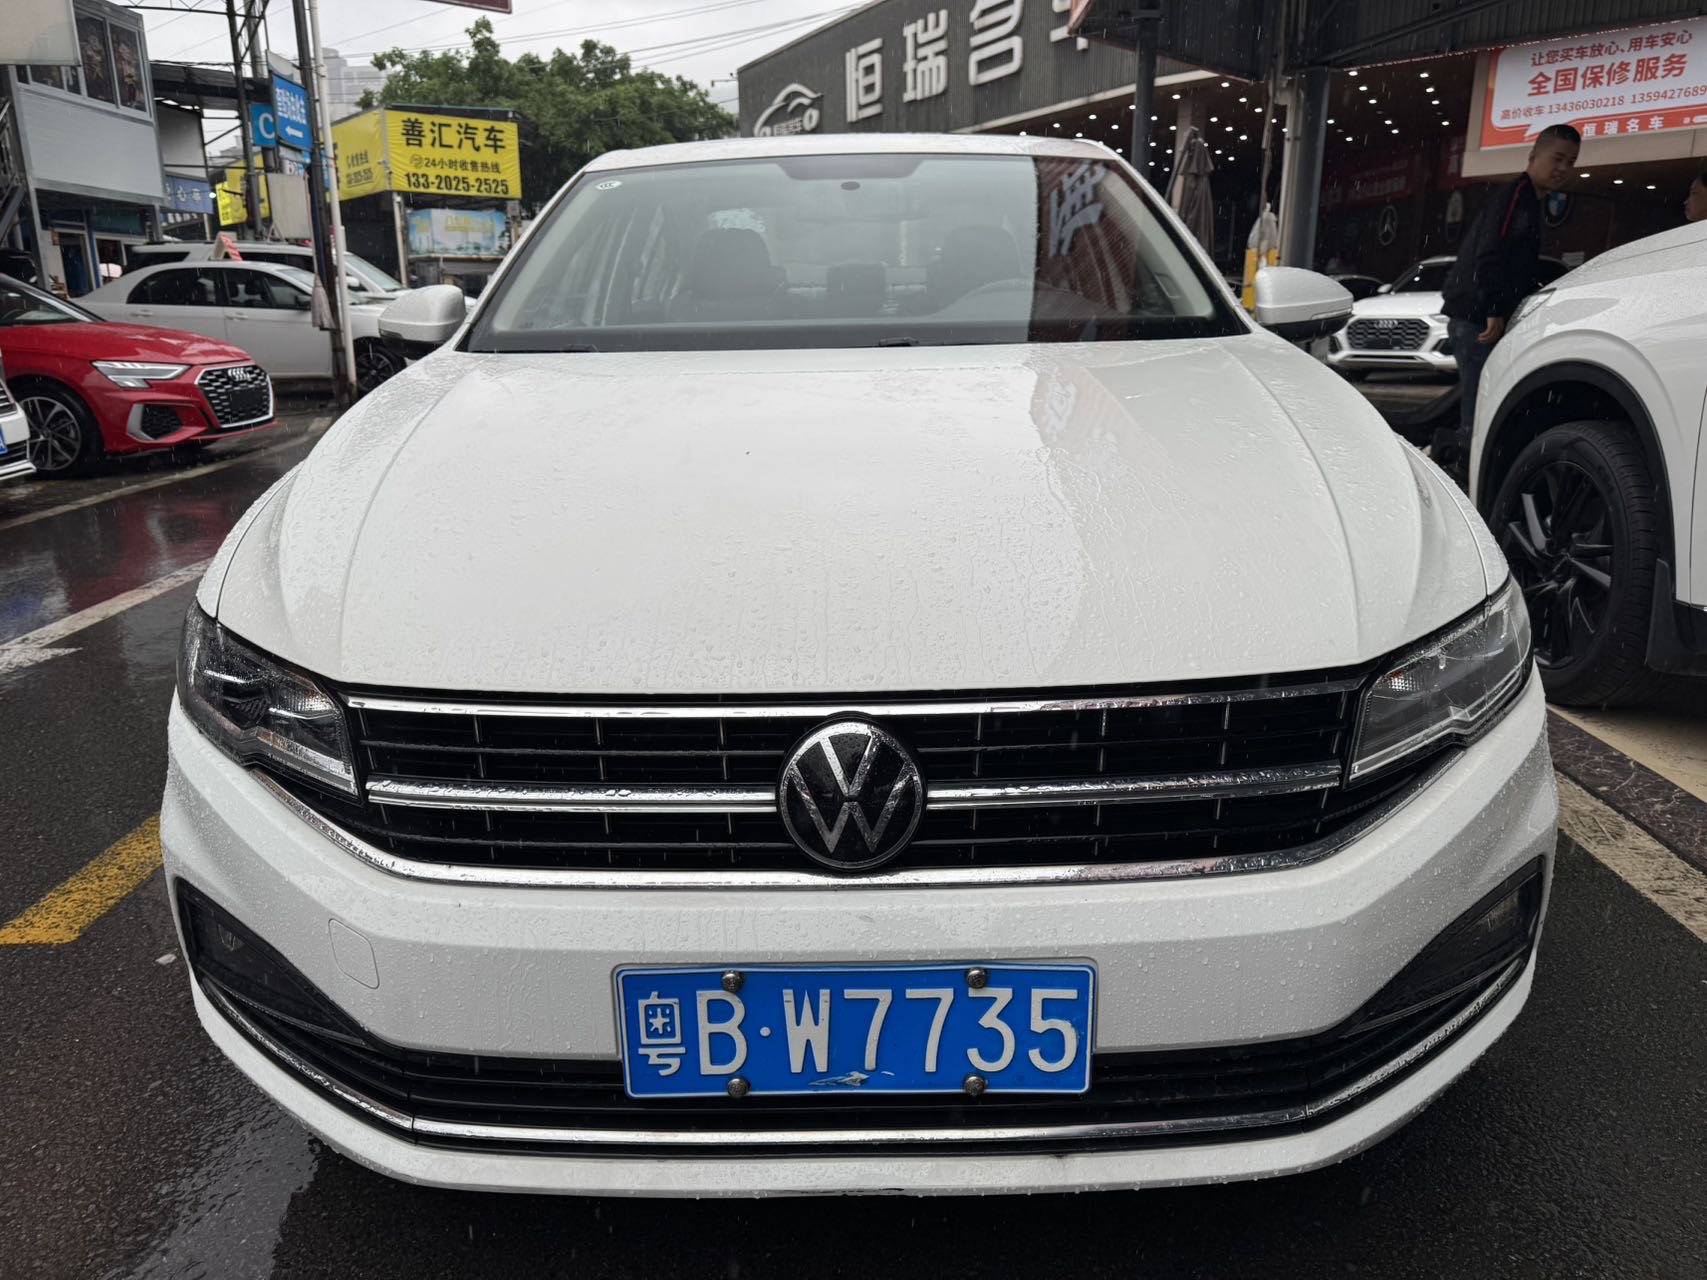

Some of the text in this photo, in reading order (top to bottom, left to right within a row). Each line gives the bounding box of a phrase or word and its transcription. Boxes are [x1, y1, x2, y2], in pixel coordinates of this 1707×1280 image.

[1531, 29, 1693, 67] 让您买车放心、用车安心
[1528, 53, 1688, 97] 全国保修服务
[1500, 103, 1545, 121] 高价收车
[1547, 95, 1625, 114] 13436030218
[401, 117, 506, 154] 善汇汽车
[1582, 115, 1665, 138] 恒瑞名车
[424, 156, 501, 174] 24小时收售热线
[405, 172, 509, 195] 133-2025-2525
